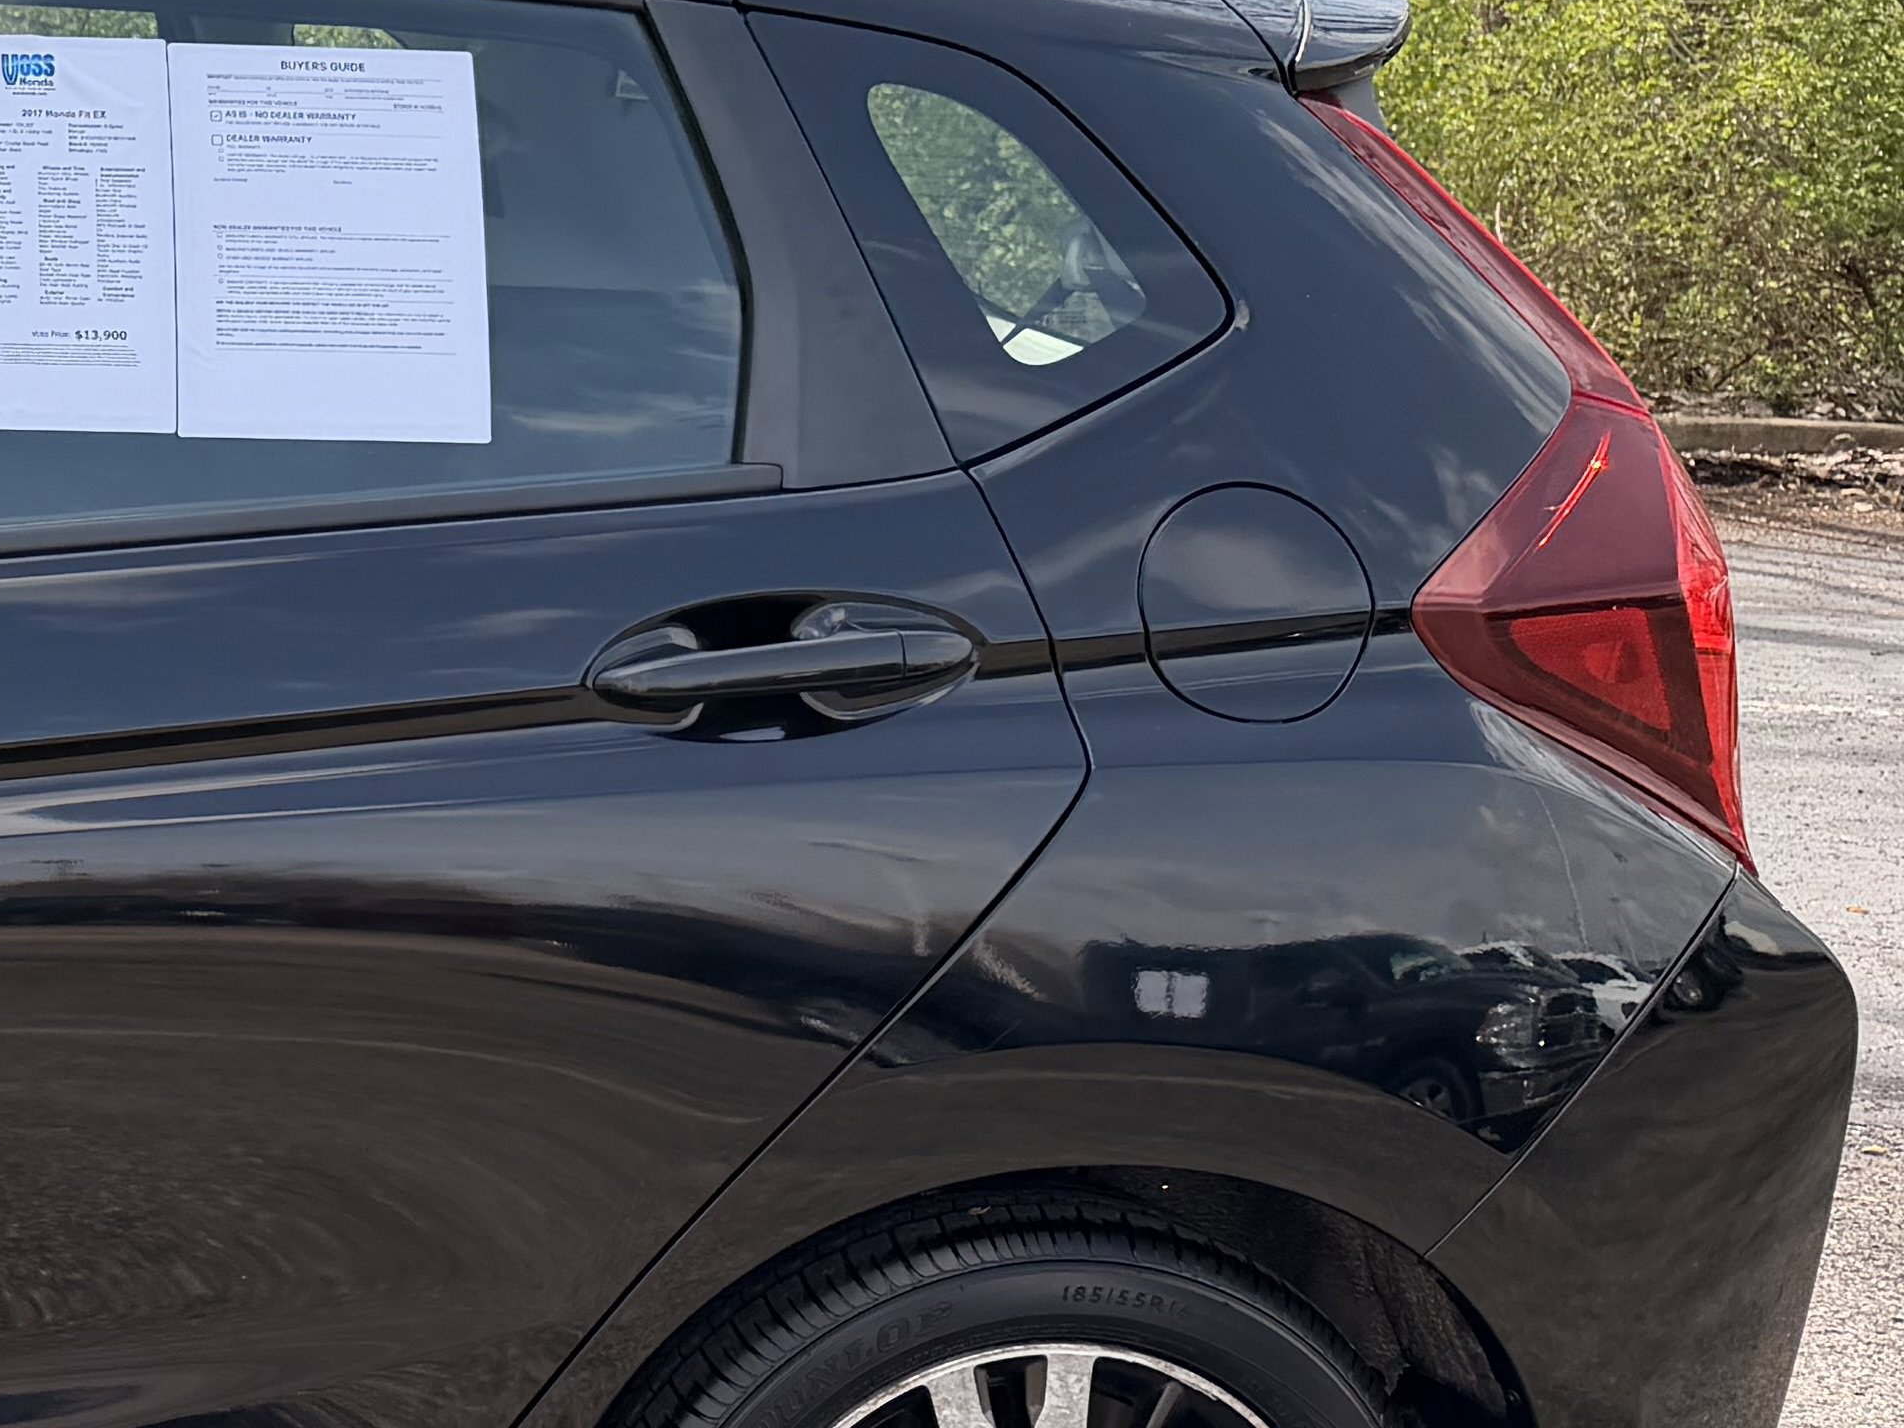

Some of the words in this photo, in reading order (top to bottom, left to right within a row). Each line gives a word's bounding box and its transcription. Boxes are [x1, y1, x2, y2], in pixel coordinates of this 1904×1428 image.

[1, 53, 55, 85] VOSS
[280, 60, 328, 72] BUYERS
[329, 62, 366, 73] GUIDE
[21, 109, 43, 118] 2017
[93, 110, 107, 120] EX
[225, 110, 237, 118] AS
[255, 110, 269, 119] NO
[270, 111, 305, 120] DEALER
[306, 112, 357, 122] WARRANTY
[226, 134, 260, 143] DEALER
[261, 135, 313, 145] WARRANTY
[74, 329, 128, 342] $13,900
